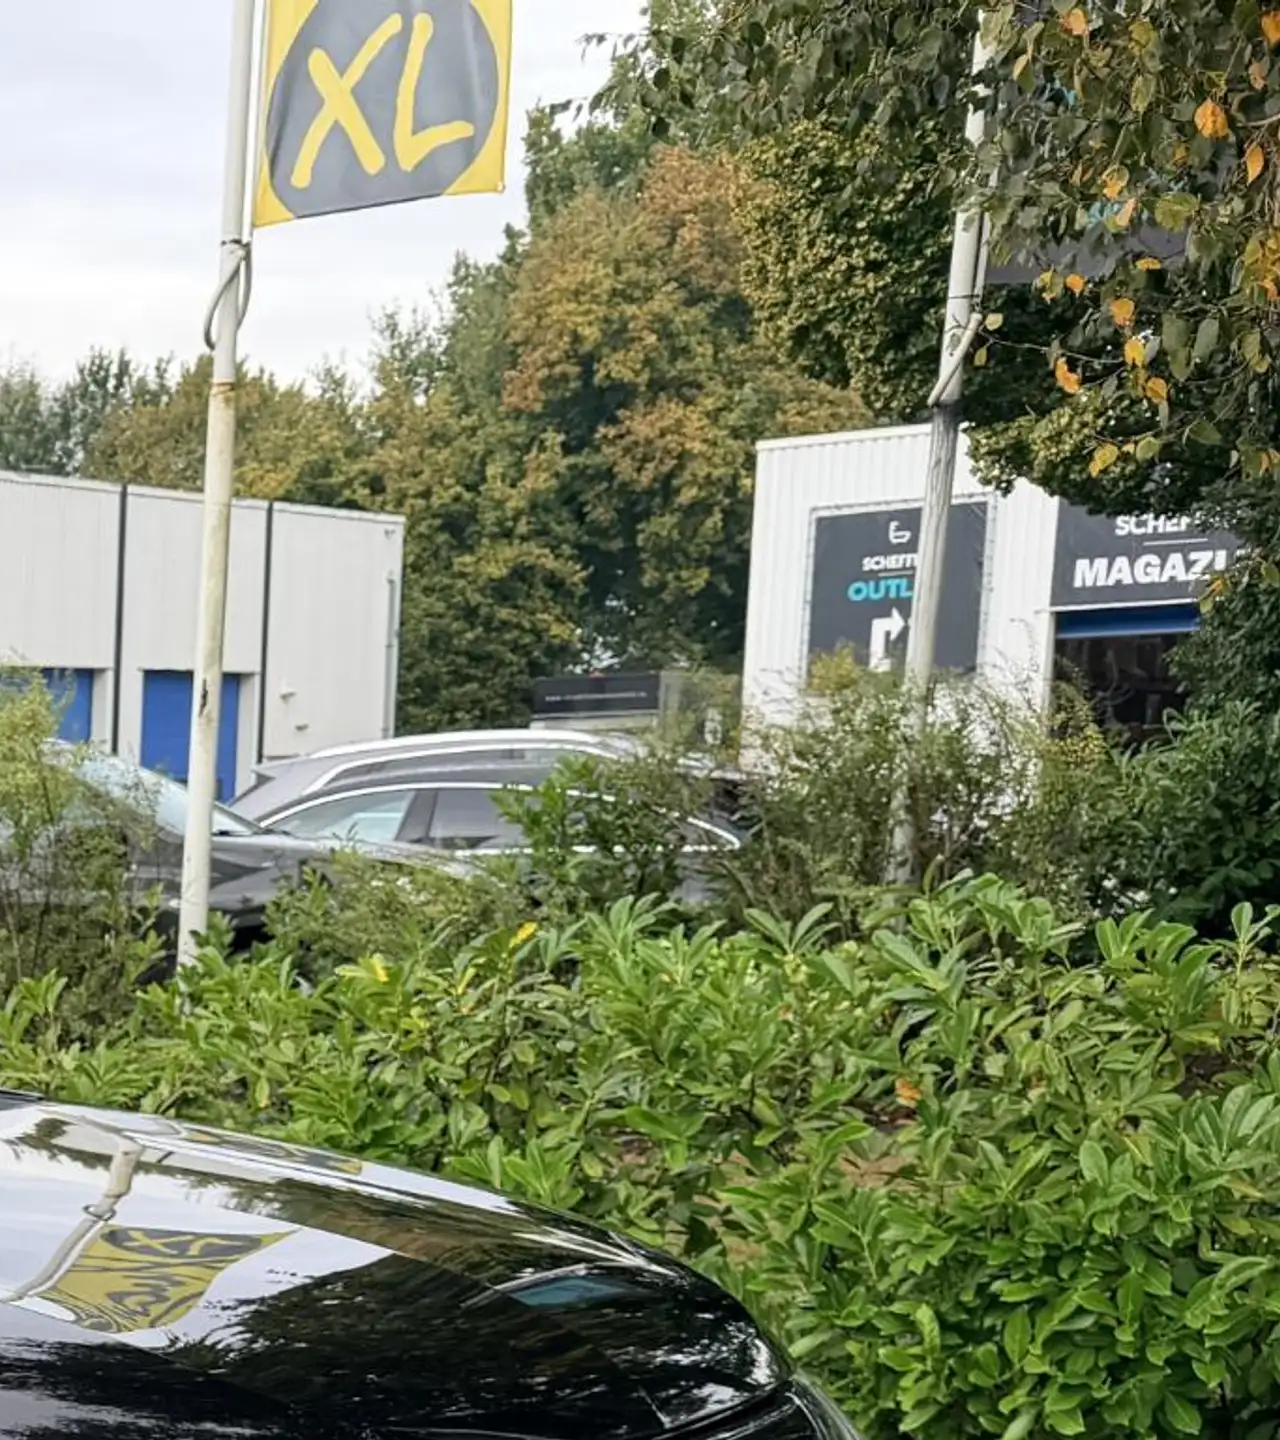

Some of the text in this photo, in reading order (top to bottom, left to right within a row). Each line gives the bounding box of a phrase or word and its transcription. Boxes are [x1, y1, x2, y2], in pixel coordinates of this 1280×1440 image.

[290, 12, 475, 189] XL
[1114, 512, 1192, 536] SCHEF
[861, 552, 919, 571] SCHEFF
[1072, 549, 1228, 588] MAGAZI
[846, 577, 914, 602] OUTL
